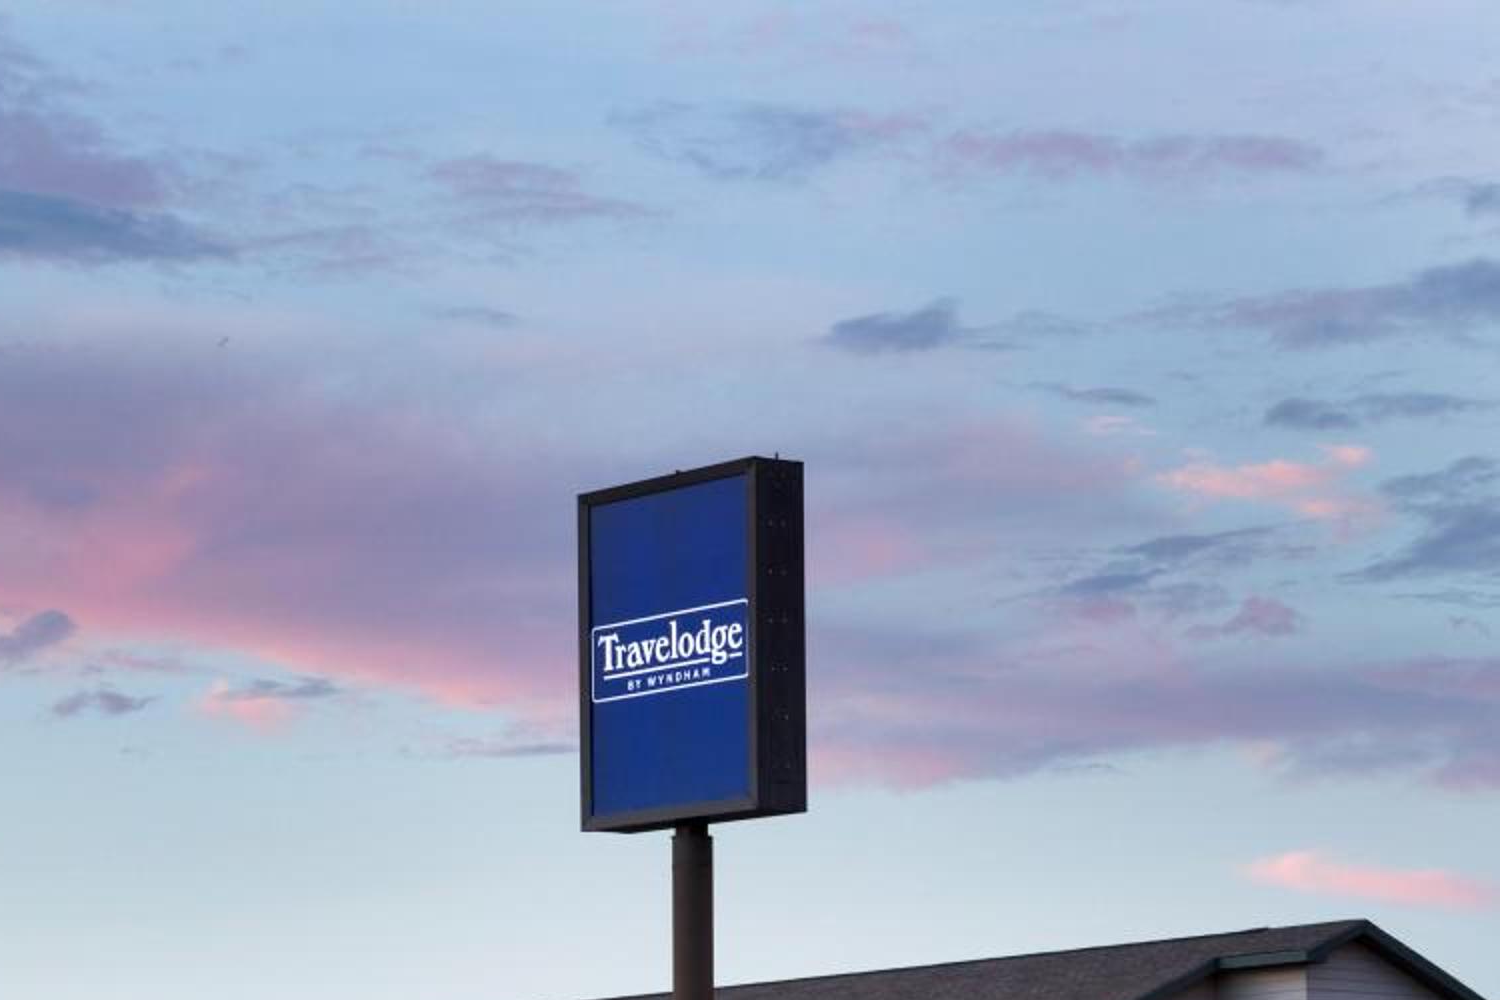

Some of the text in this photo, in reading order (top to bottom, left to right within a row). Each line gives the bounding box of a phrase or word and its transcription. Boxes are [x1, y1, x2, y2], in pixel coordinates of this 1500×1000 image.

[598, 619, 742, 671] Travelodge
[627, 667, 711, 691] BY WYNDHAM
